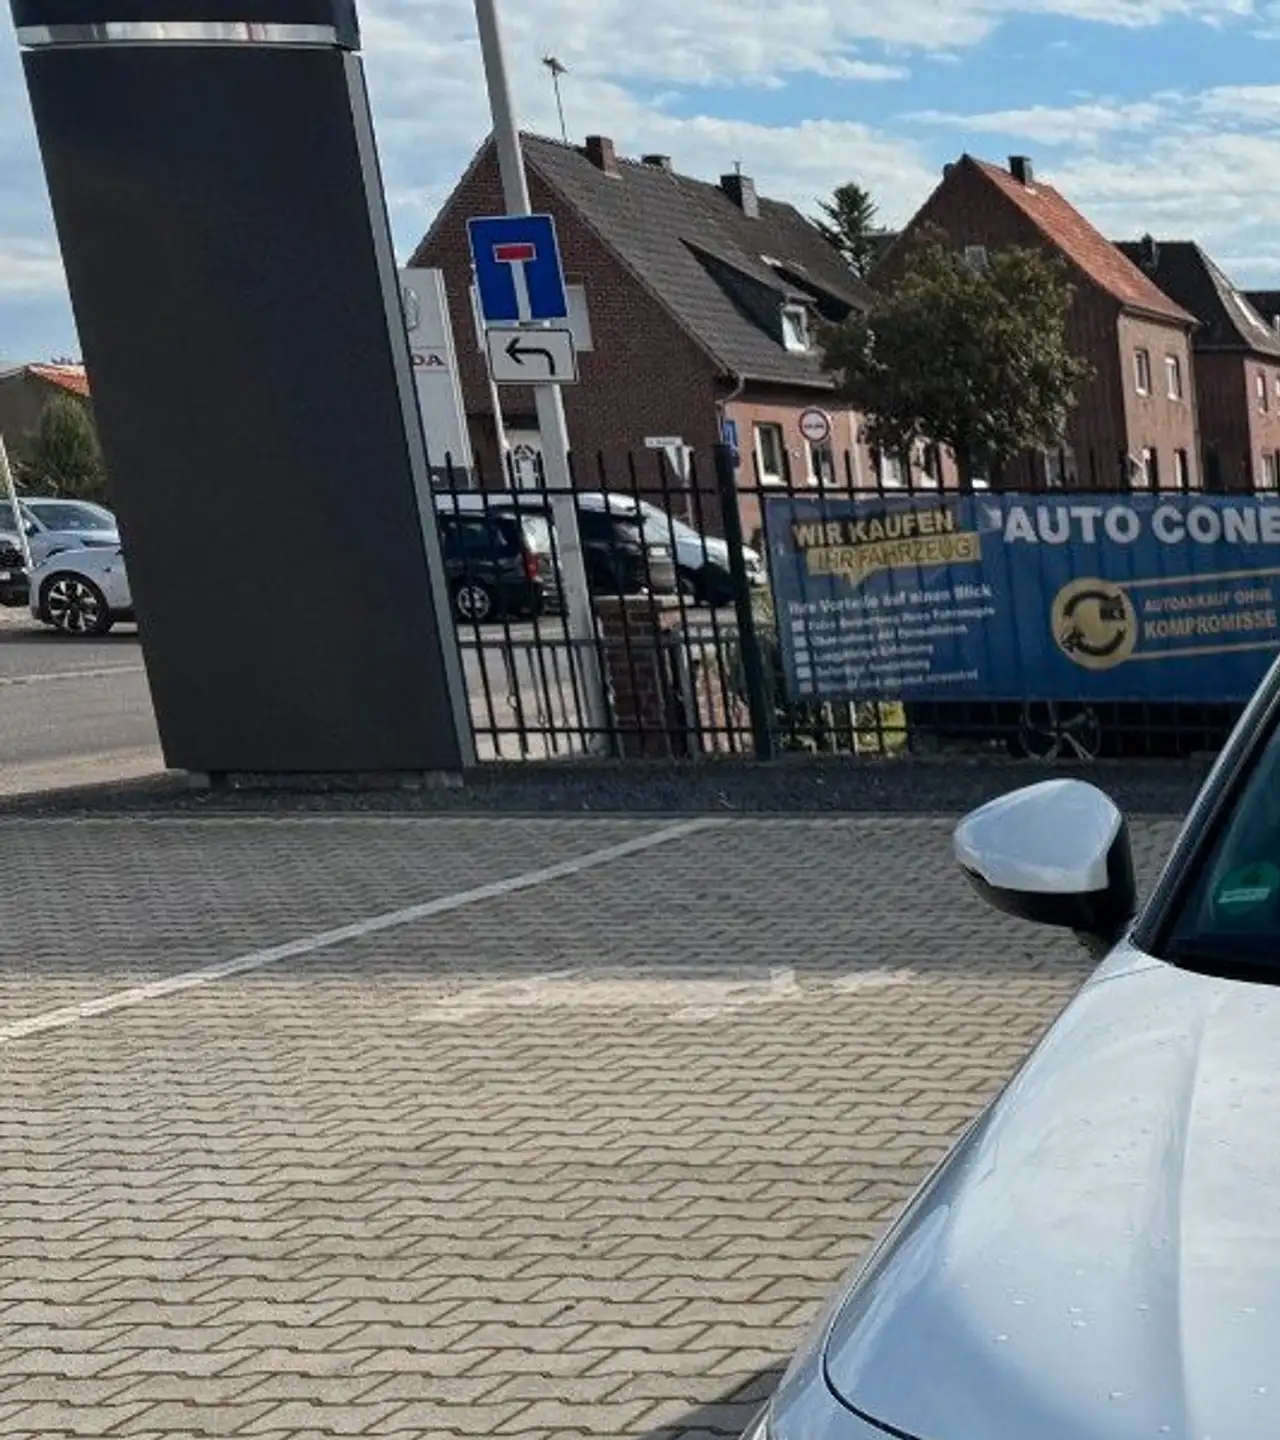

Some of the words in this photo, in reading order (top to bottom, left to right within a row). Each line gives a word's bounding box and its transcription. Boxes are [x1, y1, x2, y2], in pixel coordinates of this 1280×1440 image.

[793, 519, 843, 547] WIR
[850, 508, 955, 542] KAUFEN
[1003, 506, 1141, 545] AUTO
[819, 548, 854, 569] IHR
[860, 537, 972, 565] FAHRZEUG
[818, 594, 879, 613] Vortele
[1144, 591, 1231, 613] AUTOANKAUF
[1236, 588, 1274, 604] OHNE
[1143, 609, 1279, 640] KOMPROMISSE
